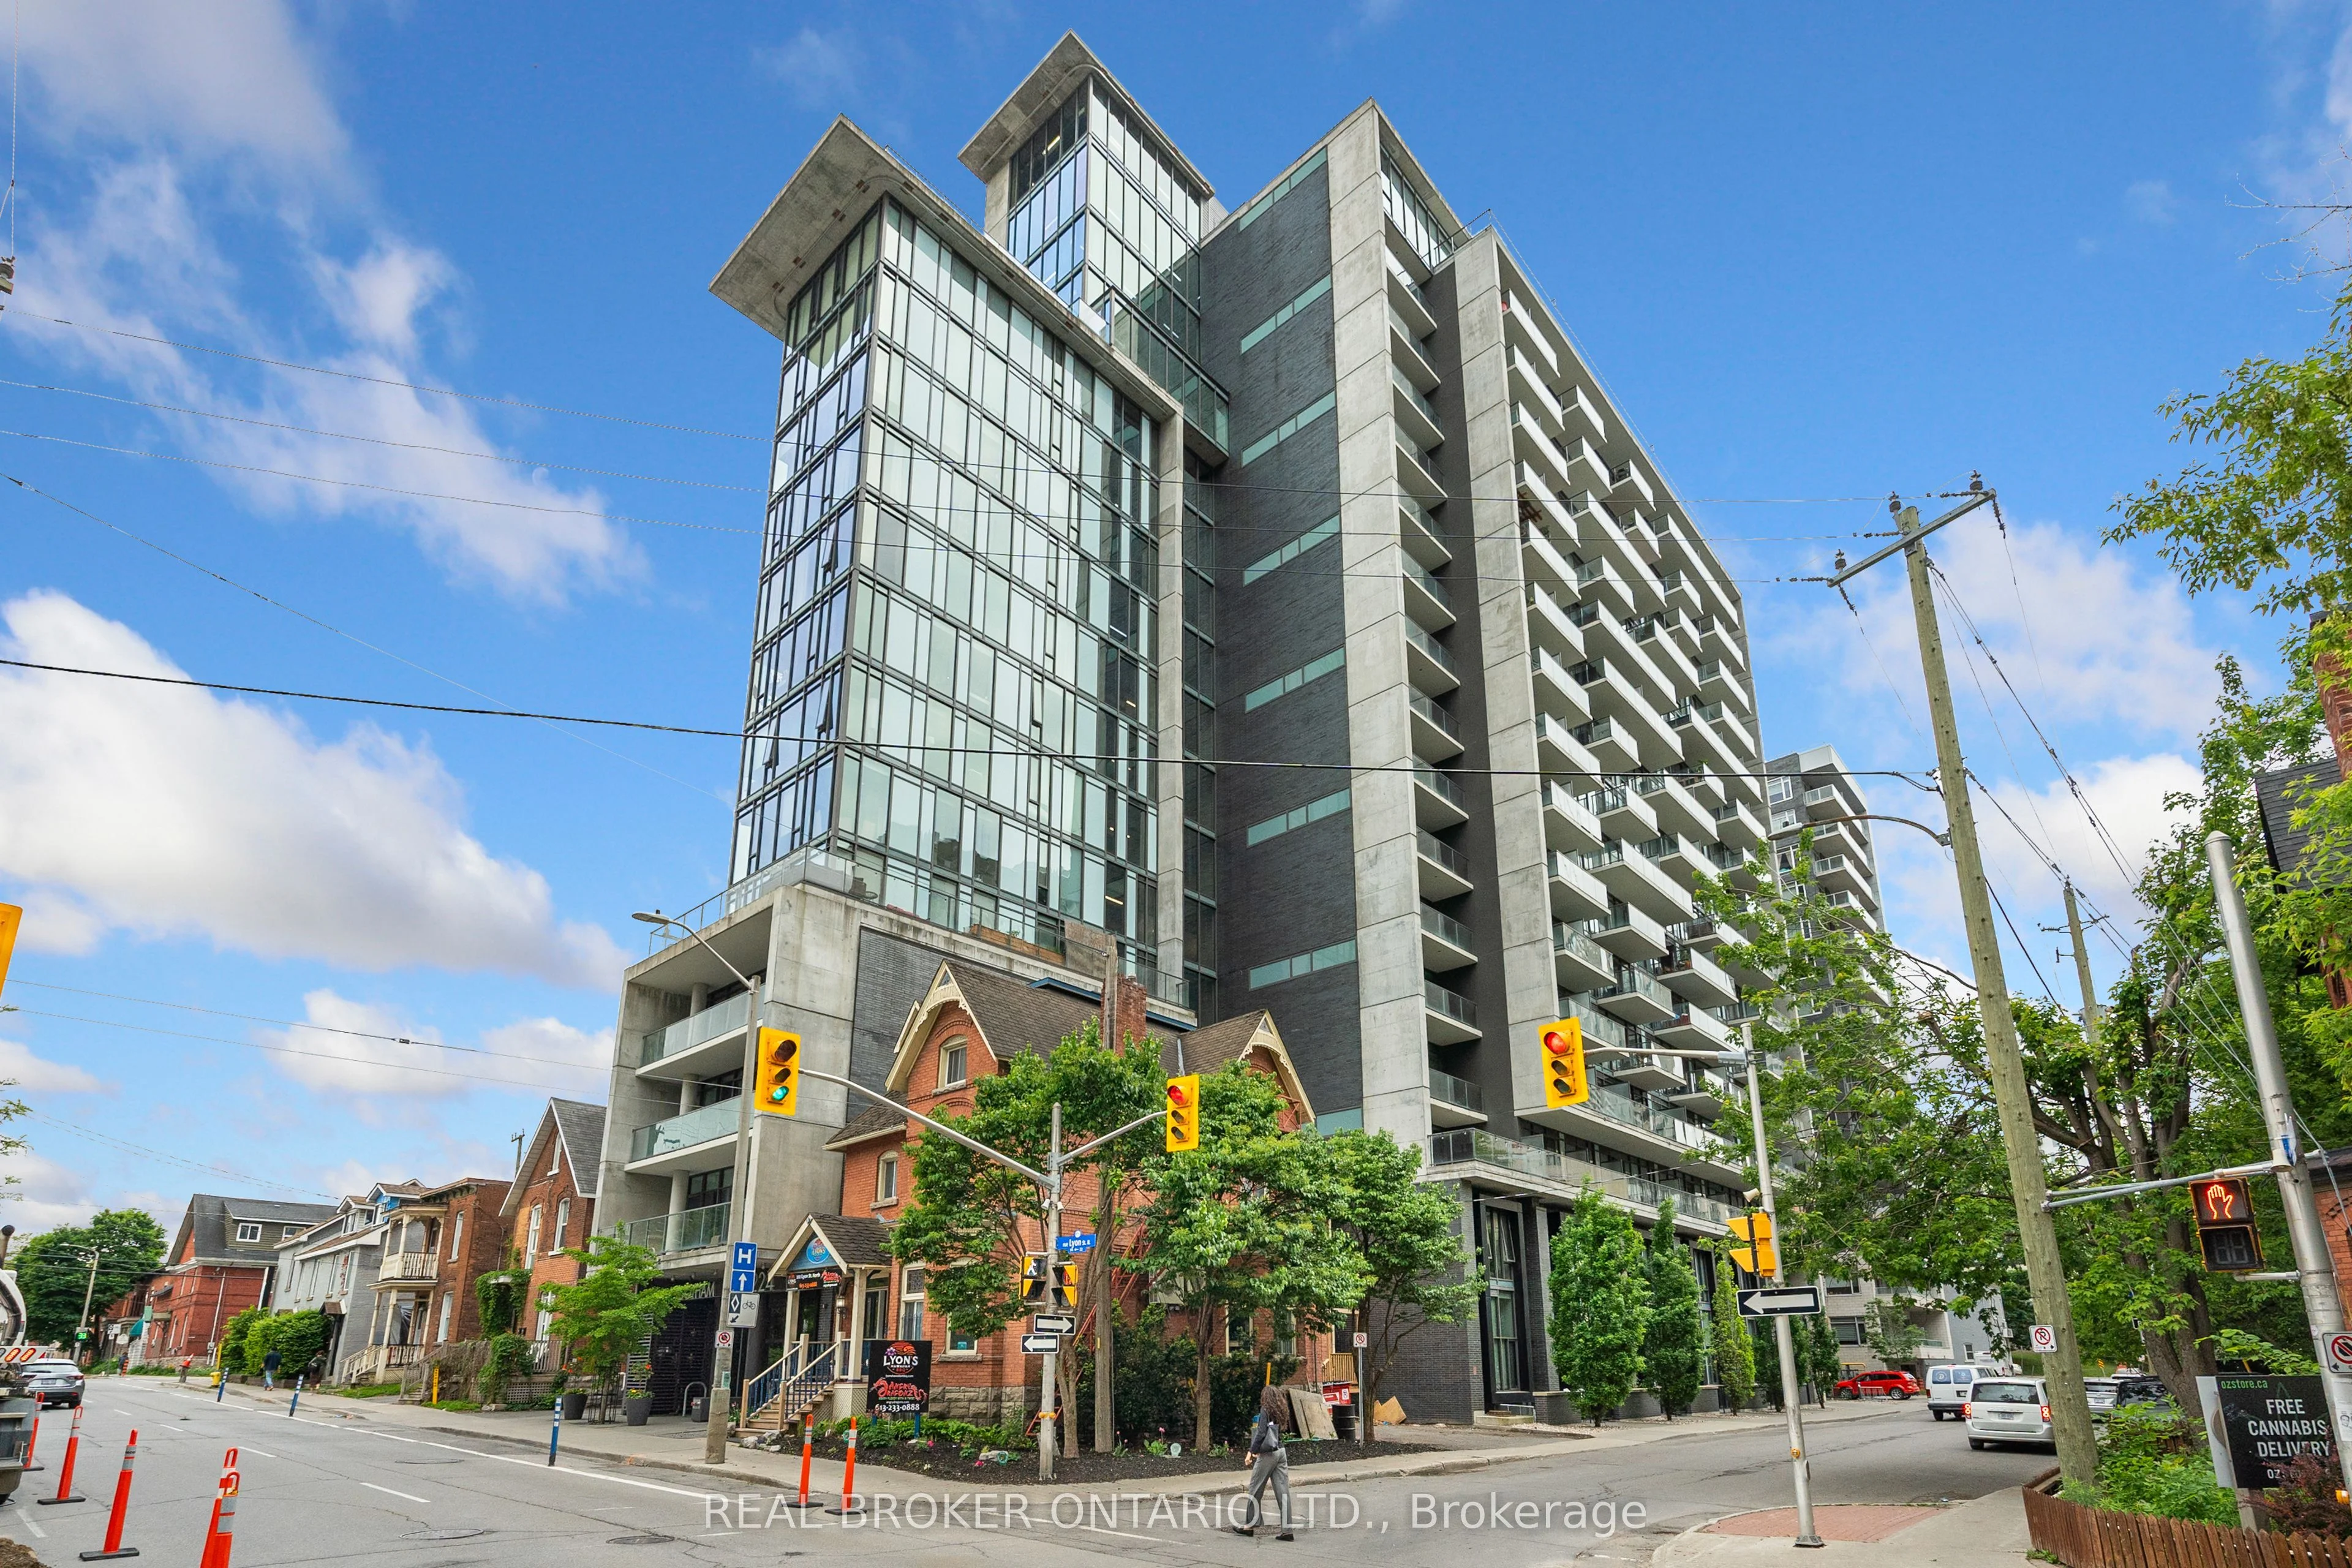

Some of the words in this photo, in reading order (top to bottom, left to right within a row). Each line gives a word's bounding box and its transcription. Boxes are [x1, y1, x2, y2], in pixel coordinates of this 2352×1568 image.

[1069, 1238, 1082, 1249] Lyon
[737, 1248, 752, 1264] H
[2220, 1379, 2268, 1389] ozstore.ca
[875, 1403, 920, 1412] 613-233-0888
[2266, 1399, 2305, 1414] FREE
[2247, 1419, 2328, 1436] CANNABIS
